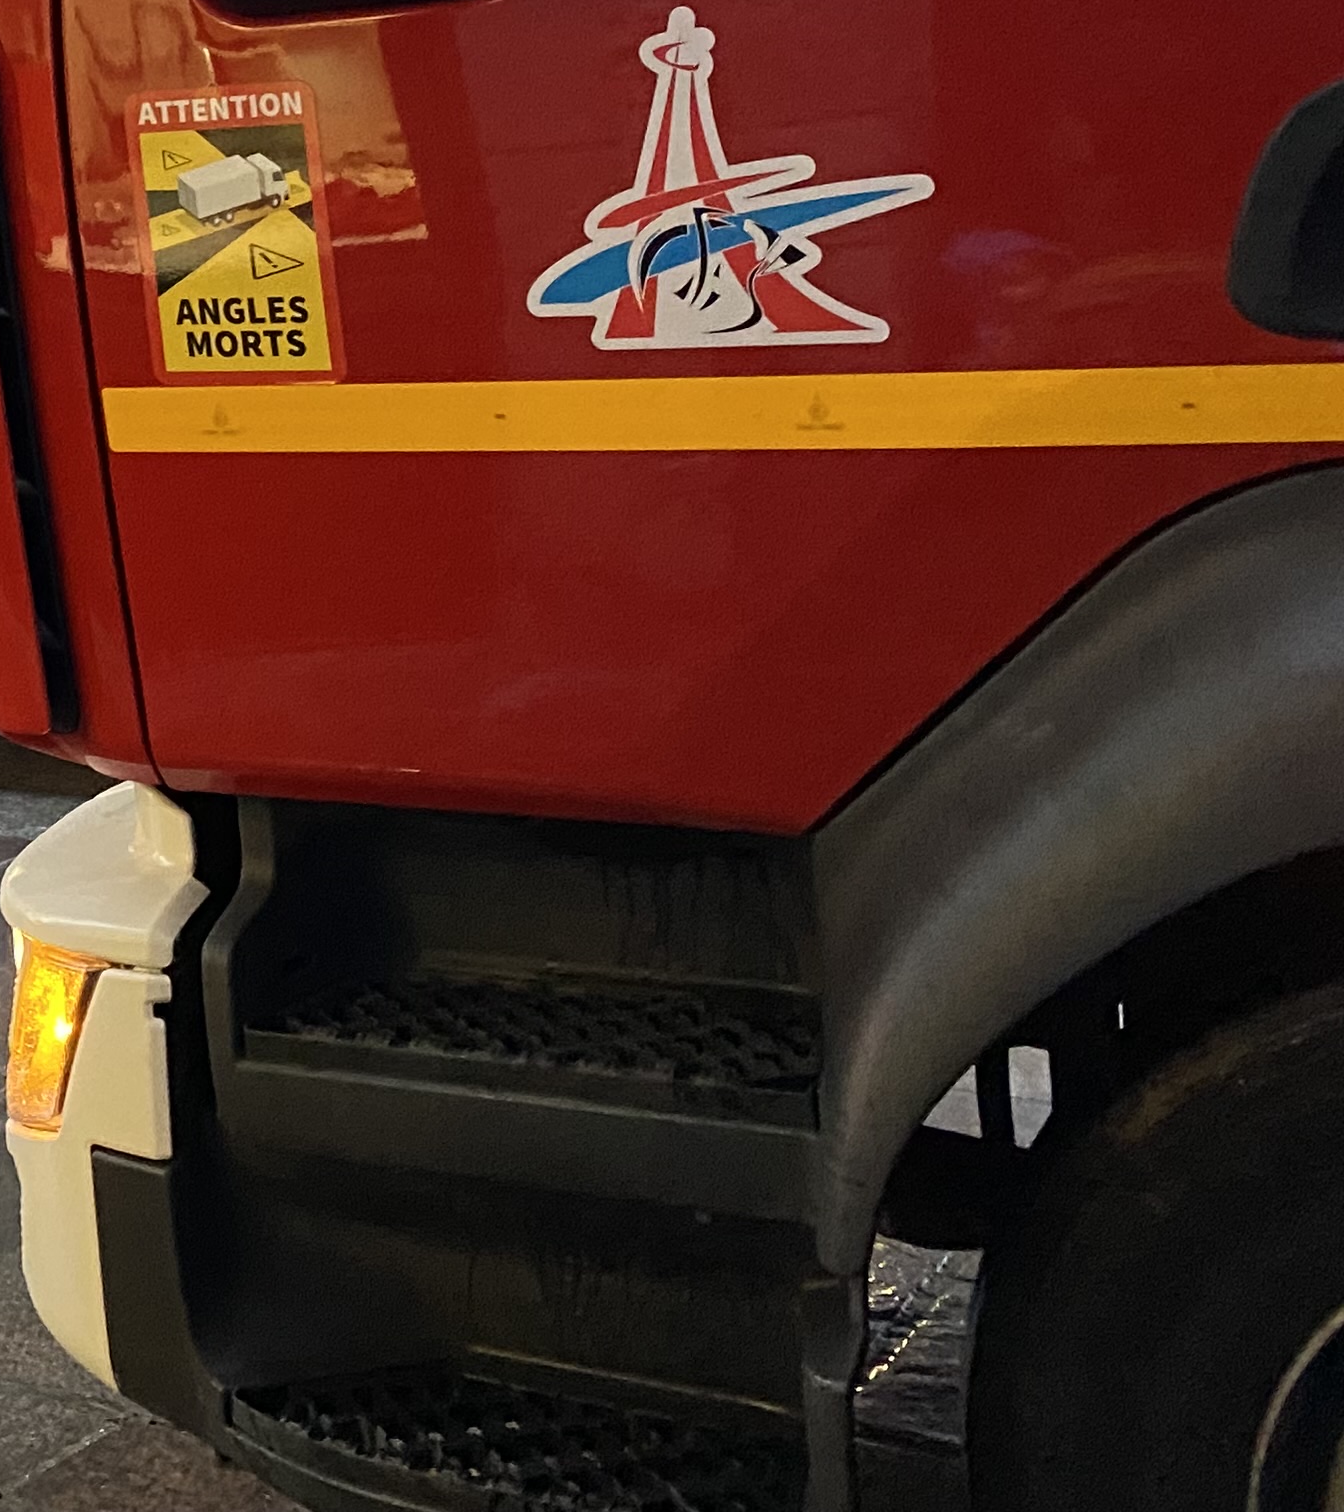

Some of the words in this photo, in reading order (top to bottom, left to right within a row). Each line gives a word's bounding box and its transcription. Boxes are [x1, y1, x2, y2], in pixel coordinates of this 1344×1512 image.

[138, 91, 304, 126] ATTENTION
[176, 296, 309, 326] ANGLES
[186, 329, 308, 358] MORTS
